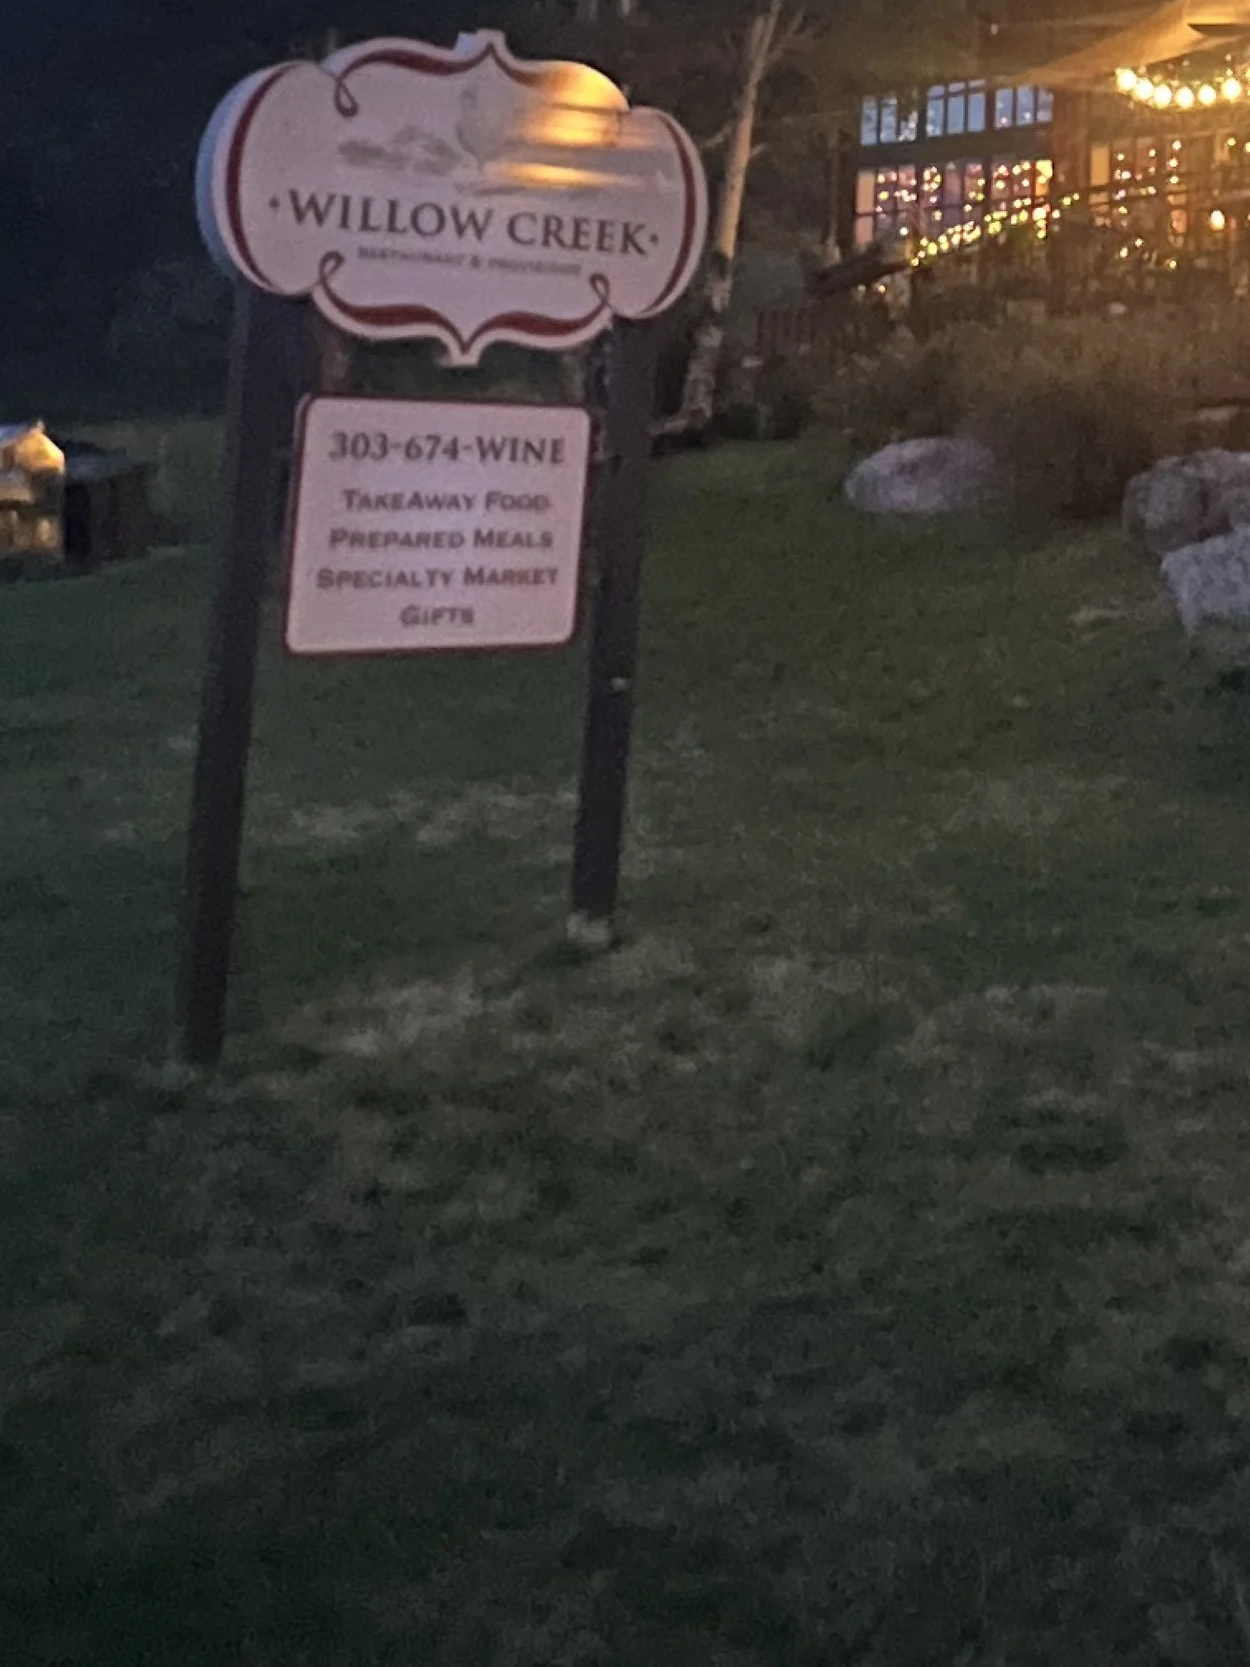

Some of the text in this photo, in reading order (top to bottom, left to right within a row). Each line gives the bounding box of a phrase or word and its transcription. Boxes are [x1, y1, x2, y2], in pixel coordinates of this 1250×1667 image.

[288, 188, 648, 256] WILLOW CREEK
[328, 432, 566, 465] 303-674-WINE
